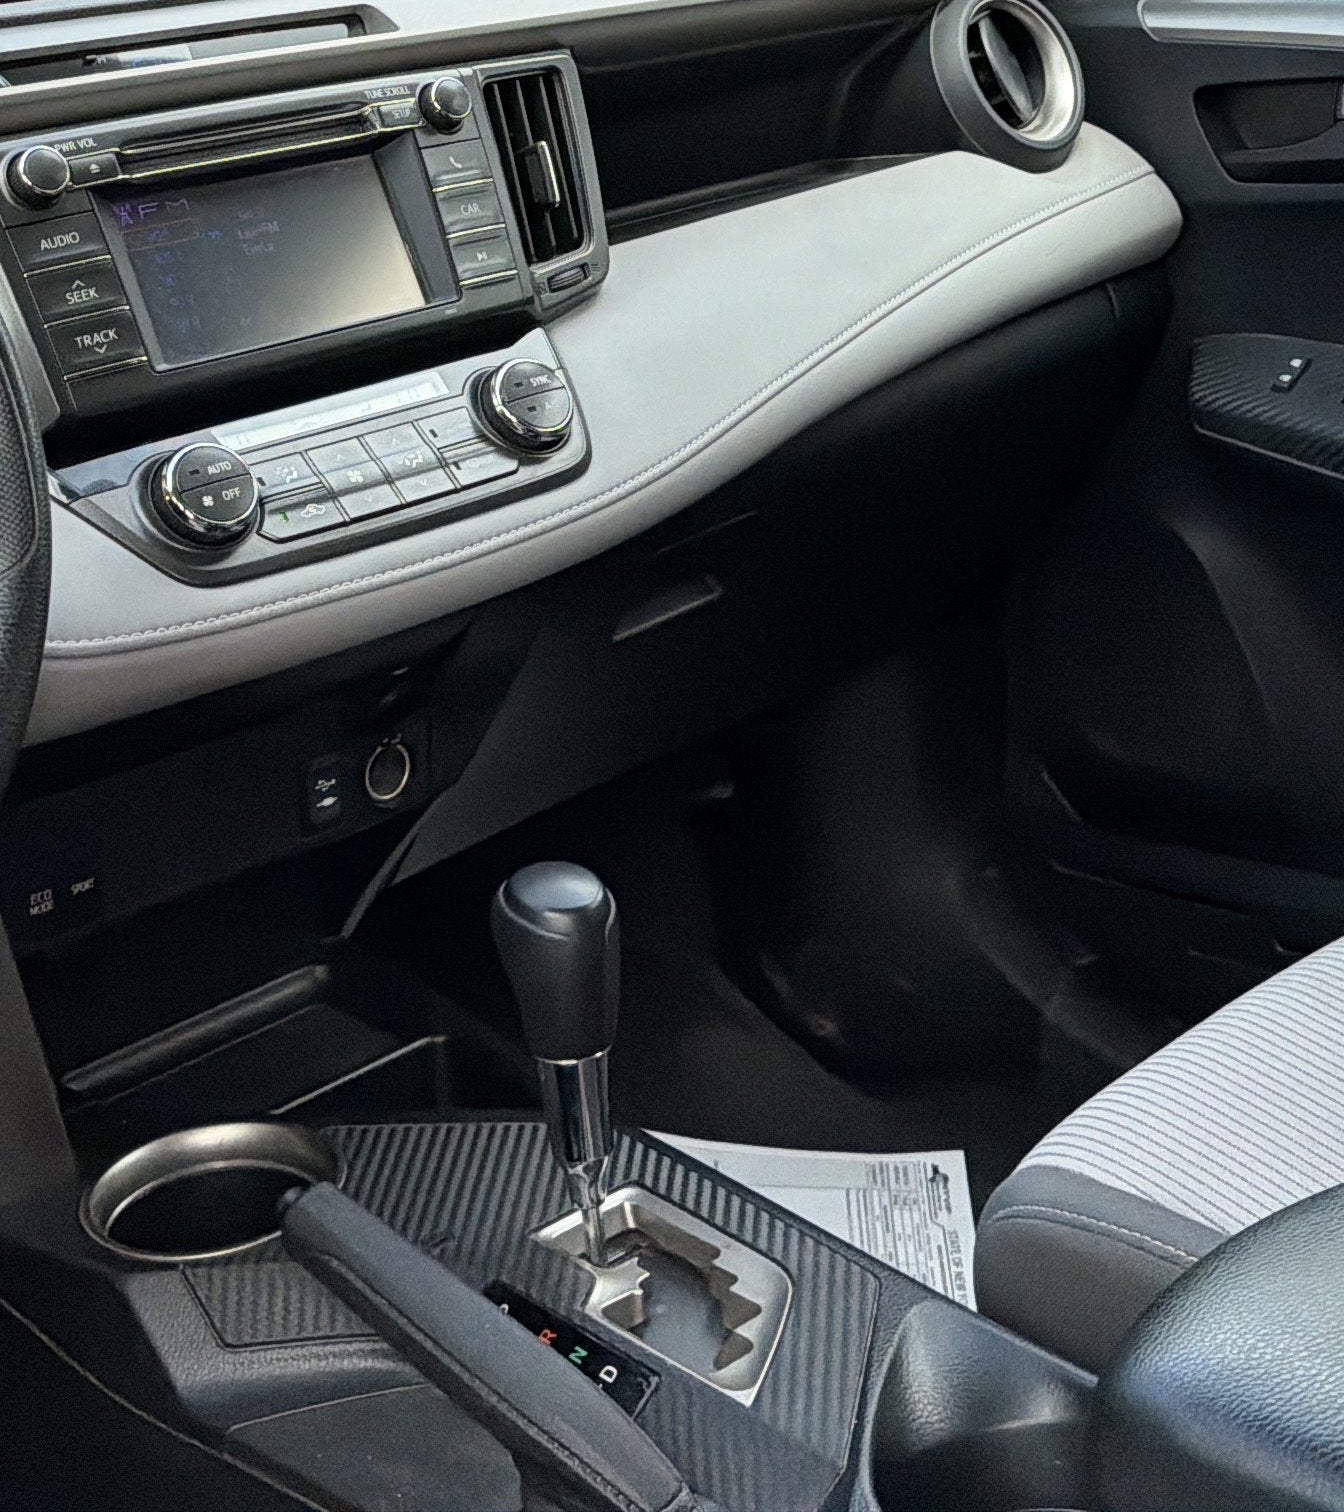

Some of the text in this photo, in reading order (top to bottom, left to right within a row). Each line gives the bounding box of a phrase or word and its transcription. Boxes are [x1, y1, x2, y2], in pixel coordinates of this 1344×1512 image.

[54, 136, 98, 153] PWR VOL
[460, 202, 482, 216] CAR
[40, 231, 81, 251] AUDIO
[65, 286, 99, 305] SEEK
[74, 327, 118, 350] TRACK
[529, 374, 552, 387] SYNC
[206, 460, 233, 477] AUTO
[221, 486, 242, 502] OFF
[30, 888, 53, 906] ECO
[538, 1328, 618, 1384] R N D
